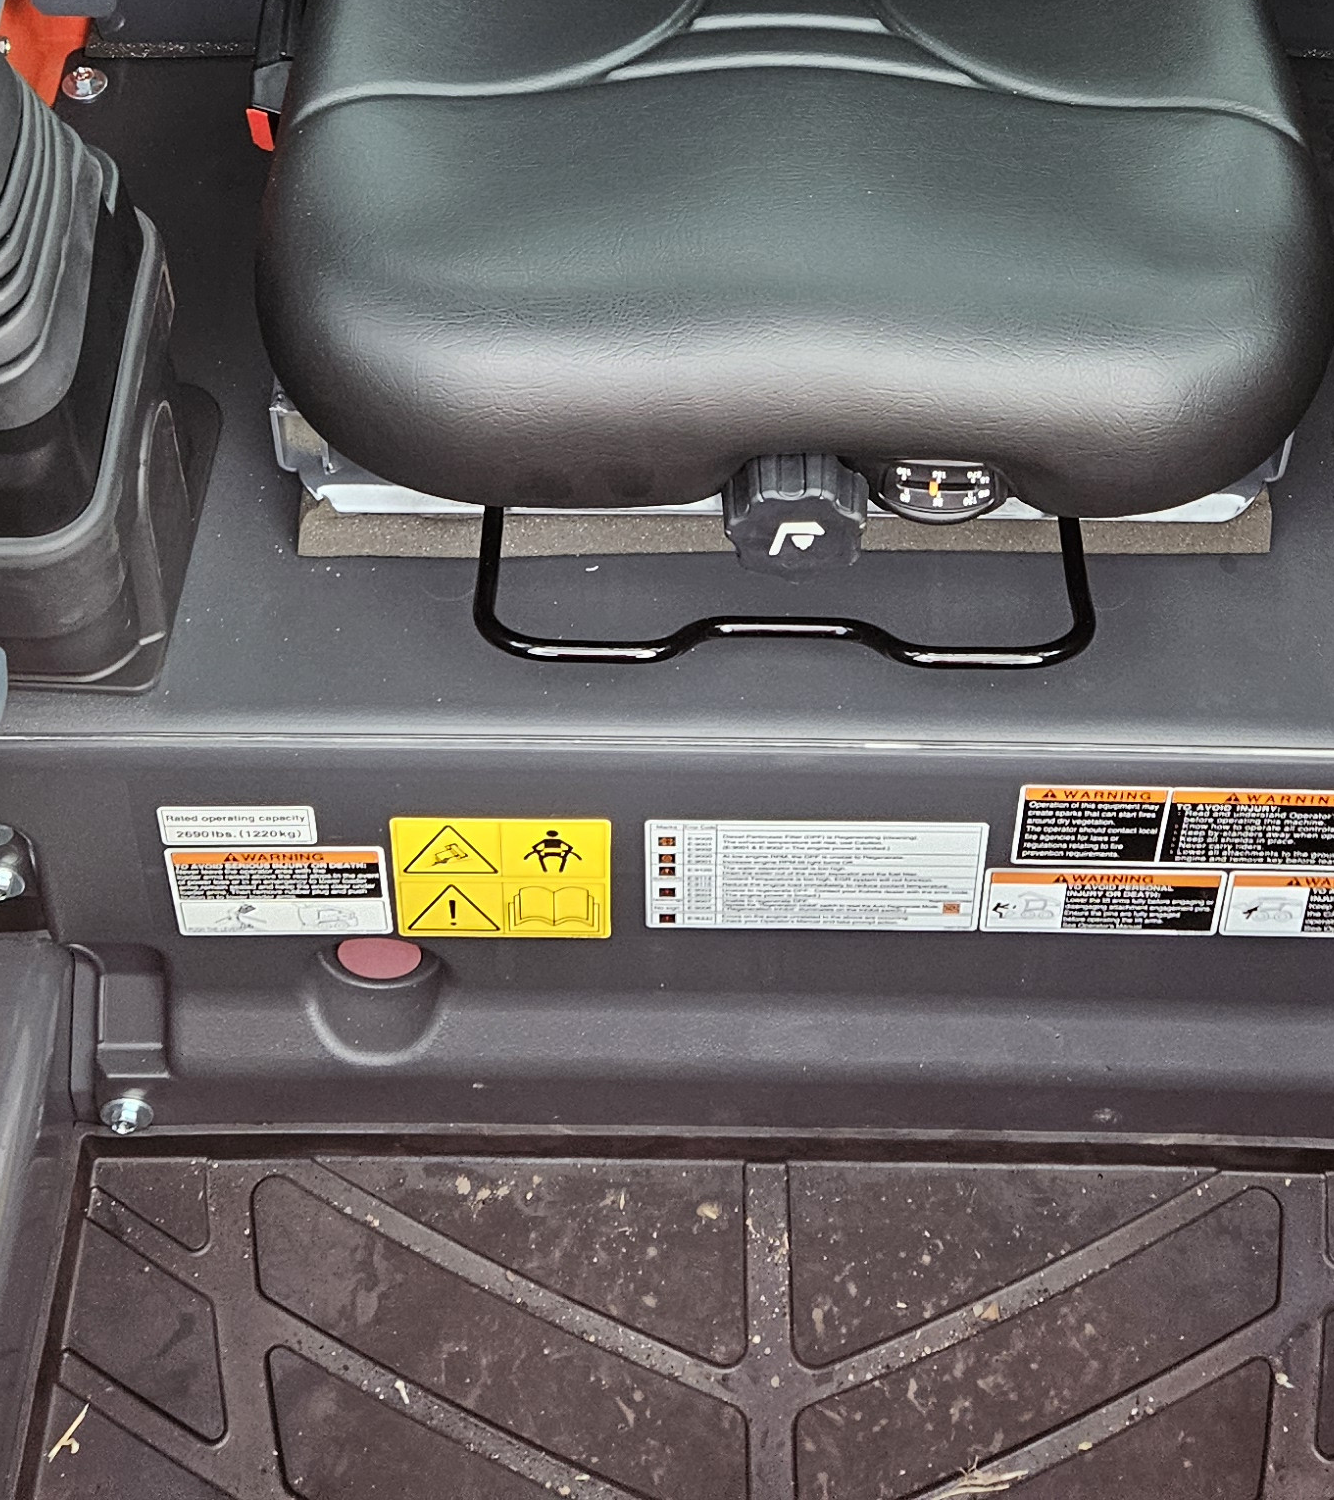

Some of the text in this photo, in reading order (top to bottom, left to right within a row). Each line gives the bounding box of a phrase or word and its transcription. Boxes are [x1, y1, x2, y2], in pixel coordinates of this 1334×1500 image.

[1063, 790, 1151, 800] WARNING
[201, 814, 255, 823] operating
[259, 814, 305, 822] capacity
[1233, 811, 1286, 819] understand
[1026, 825, 1041, 833] The
[1244, 824, 1281, 832] operate
[241, 852, 323, 861] WARNING
[1072, 875, 1153, 883] WARNING
